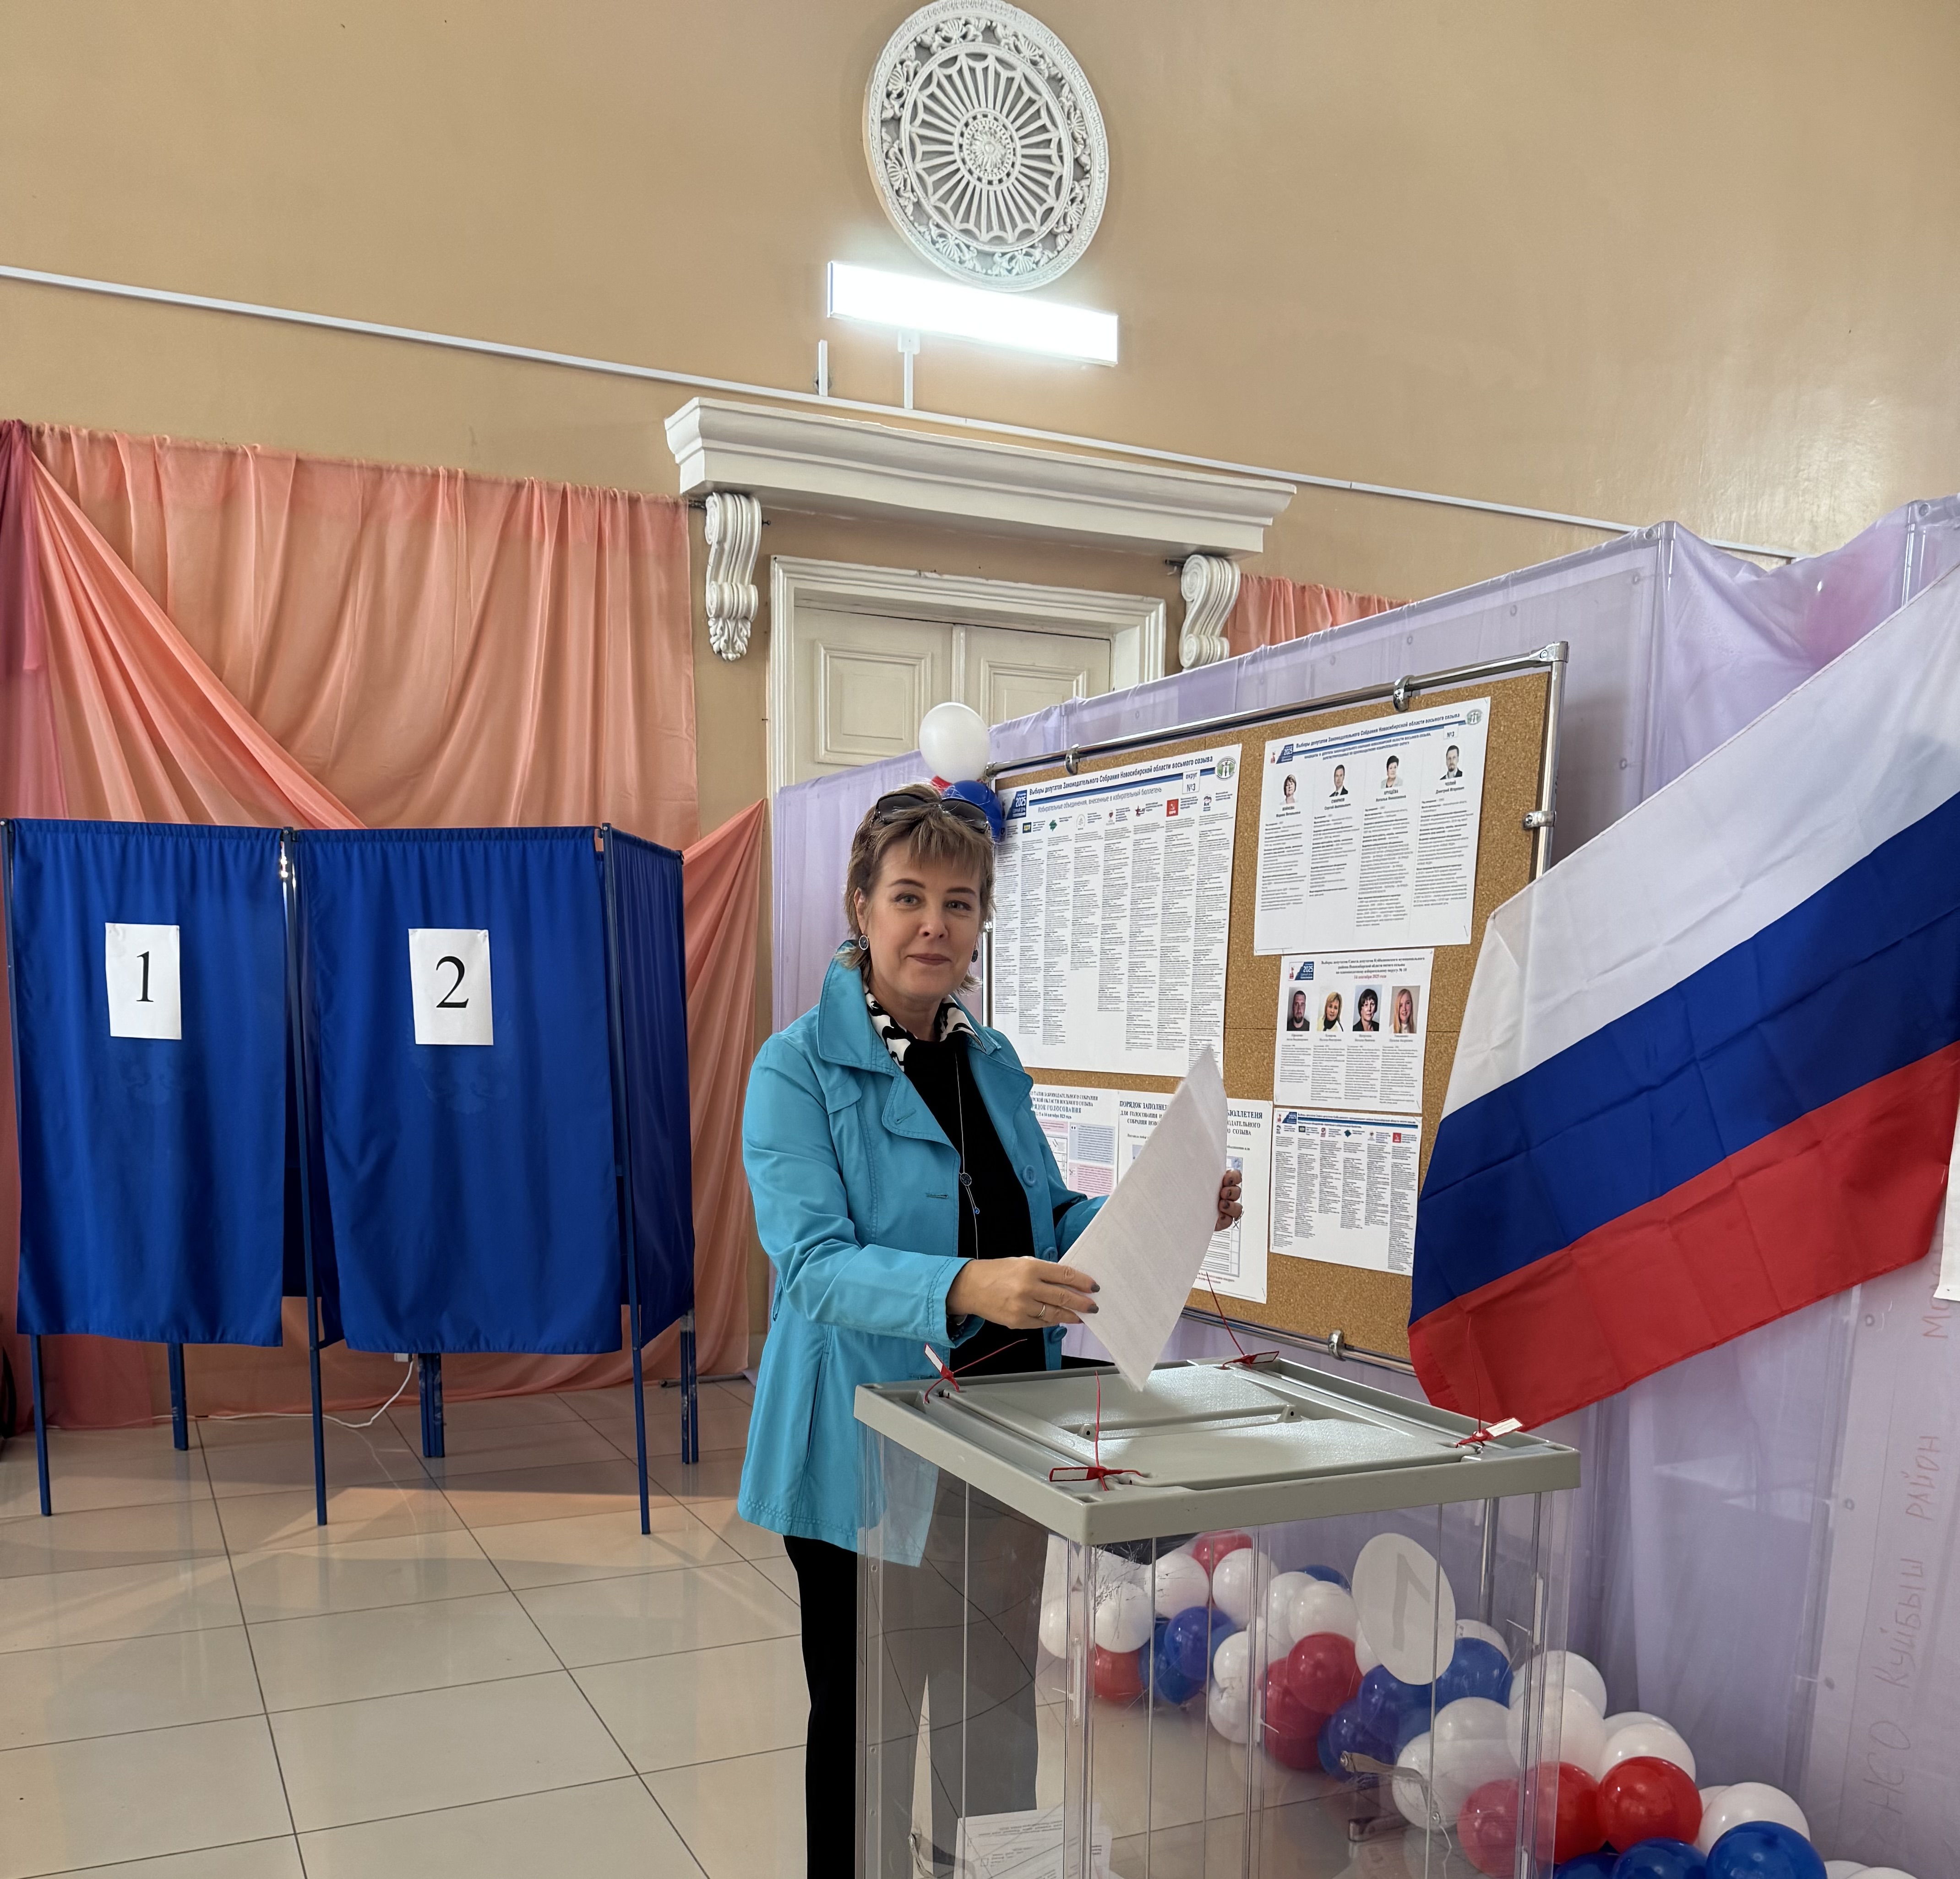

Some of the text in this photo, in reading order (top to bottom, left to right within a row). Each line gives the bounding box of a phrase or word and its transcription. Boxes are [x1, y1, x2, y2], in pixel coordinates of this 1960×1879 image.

[1029, 756, 1213, 795] Выборы депутатов Законодательного Собрания Новосибирской области восьмого созыва
[1015, 796, 1026, 807] 2025
[1141, 787, 1162, 796] бюллетень
[136, 951, 154, 1002] 1
[436, 956, 469, 1009] 2
[1047, 1105, 1081, 1113] ГОЛОСОВАНИЯ
